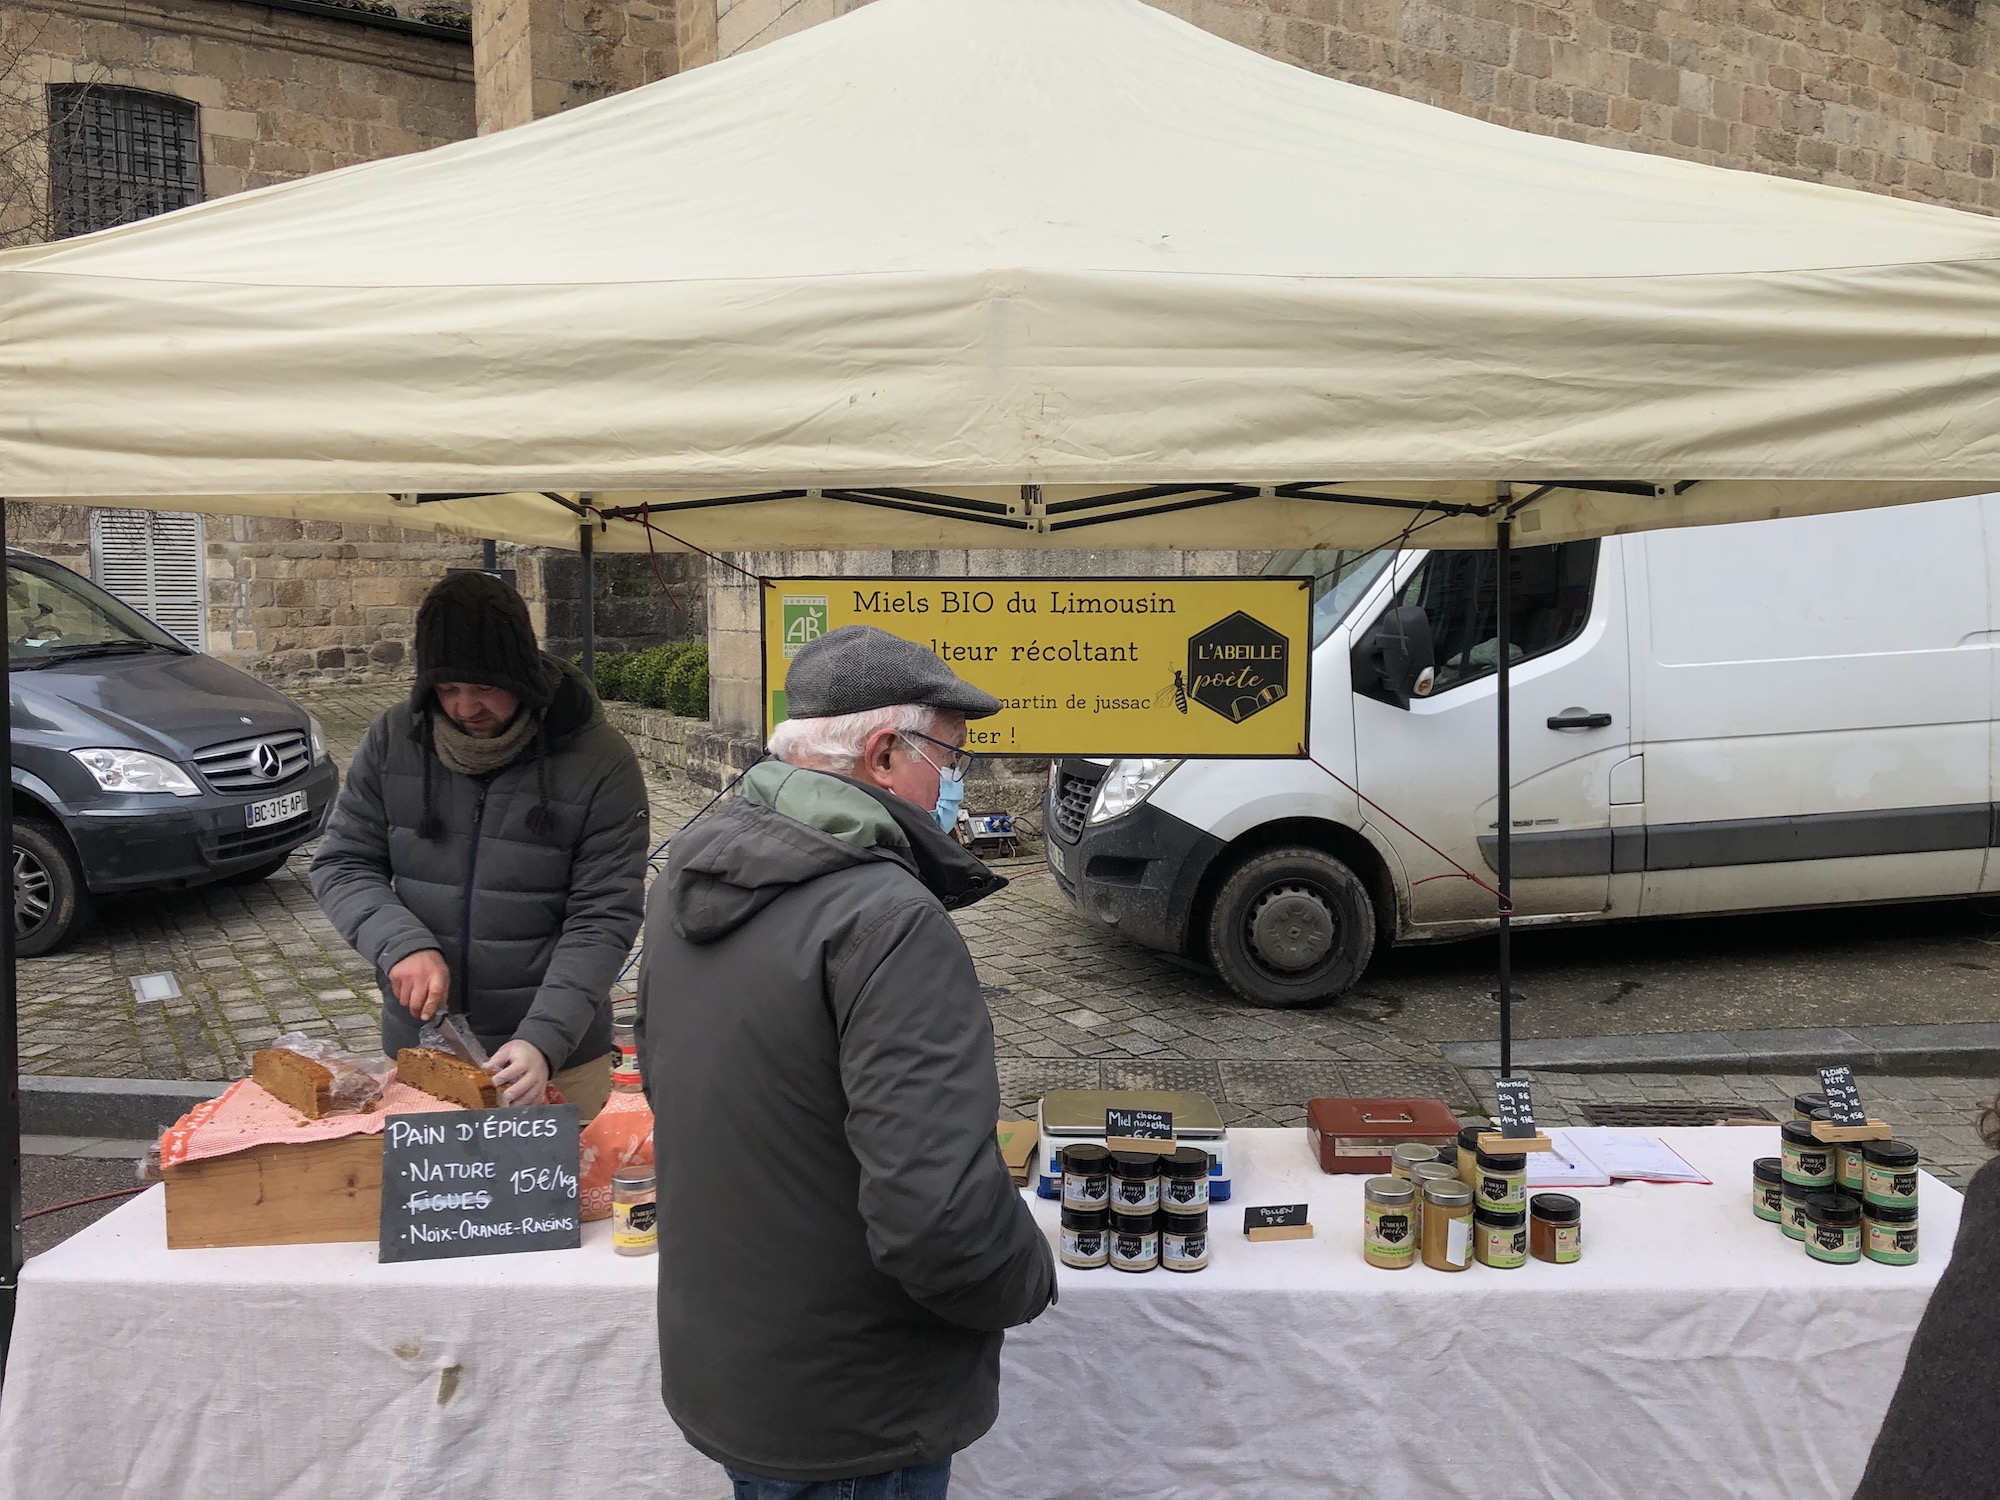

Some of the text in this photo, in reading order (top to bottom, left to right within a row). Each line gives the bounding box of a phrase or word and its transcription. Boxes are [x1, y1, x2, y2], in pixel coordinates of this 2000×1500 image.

[853, 590, 1176, 614] Miels BIO du Limousin
[787, 616, 821, 642] AB
[931, 638, 1138, 661] lteur récoltant
[1198, 643, 1283, 660] L'ABEILLE
[1191, 665, 1264, 698] poète
[1065, 693, 1087, 710] de
[1093, 694, 1151, 713] jussac
[968, 727, 1001, 744] ter
[456, 1115, 558, 1143] D'ÉPICES
[1108, 1111, 1132, 1128] Miel
[410, 1158, 579, 1199] NATURE 15€/kg
[1260, 1205, 1295, 1217] POLLEN
